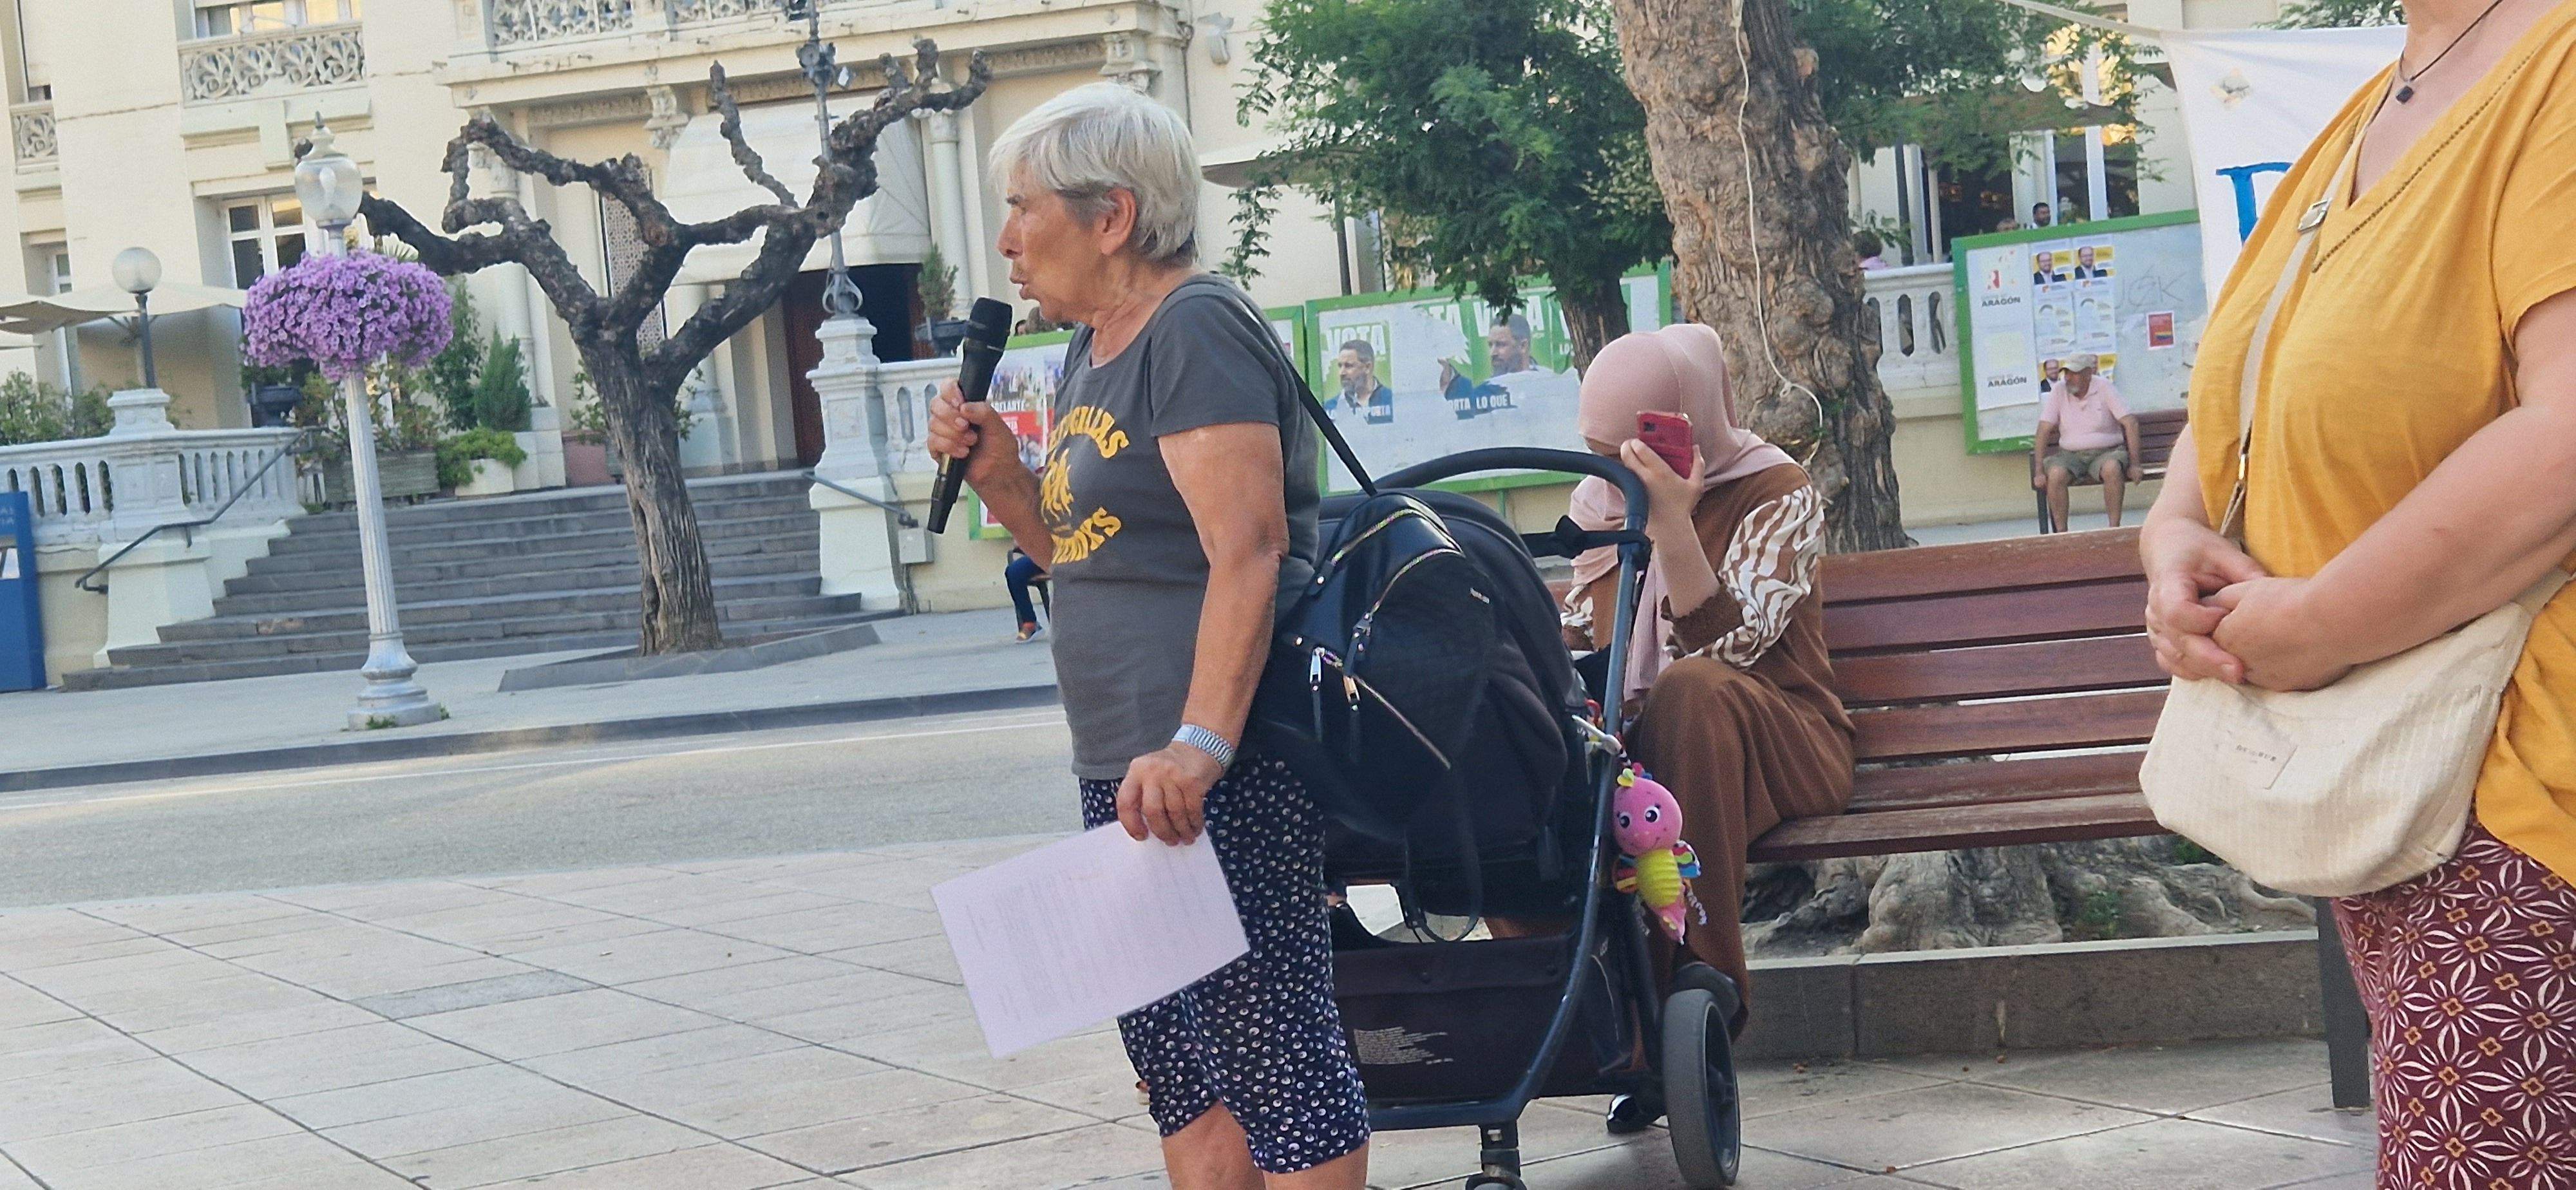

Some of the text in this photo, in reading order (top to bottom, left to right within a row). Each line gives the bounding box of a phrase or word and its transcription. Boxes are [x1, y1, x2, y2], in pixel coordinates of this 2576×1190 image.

[1982, 296, 2021, 307] ARAGÓN
[1987, 376, 2027, 388] ARAGÓN
[1475, 394, 1508, 410] LO QUE
